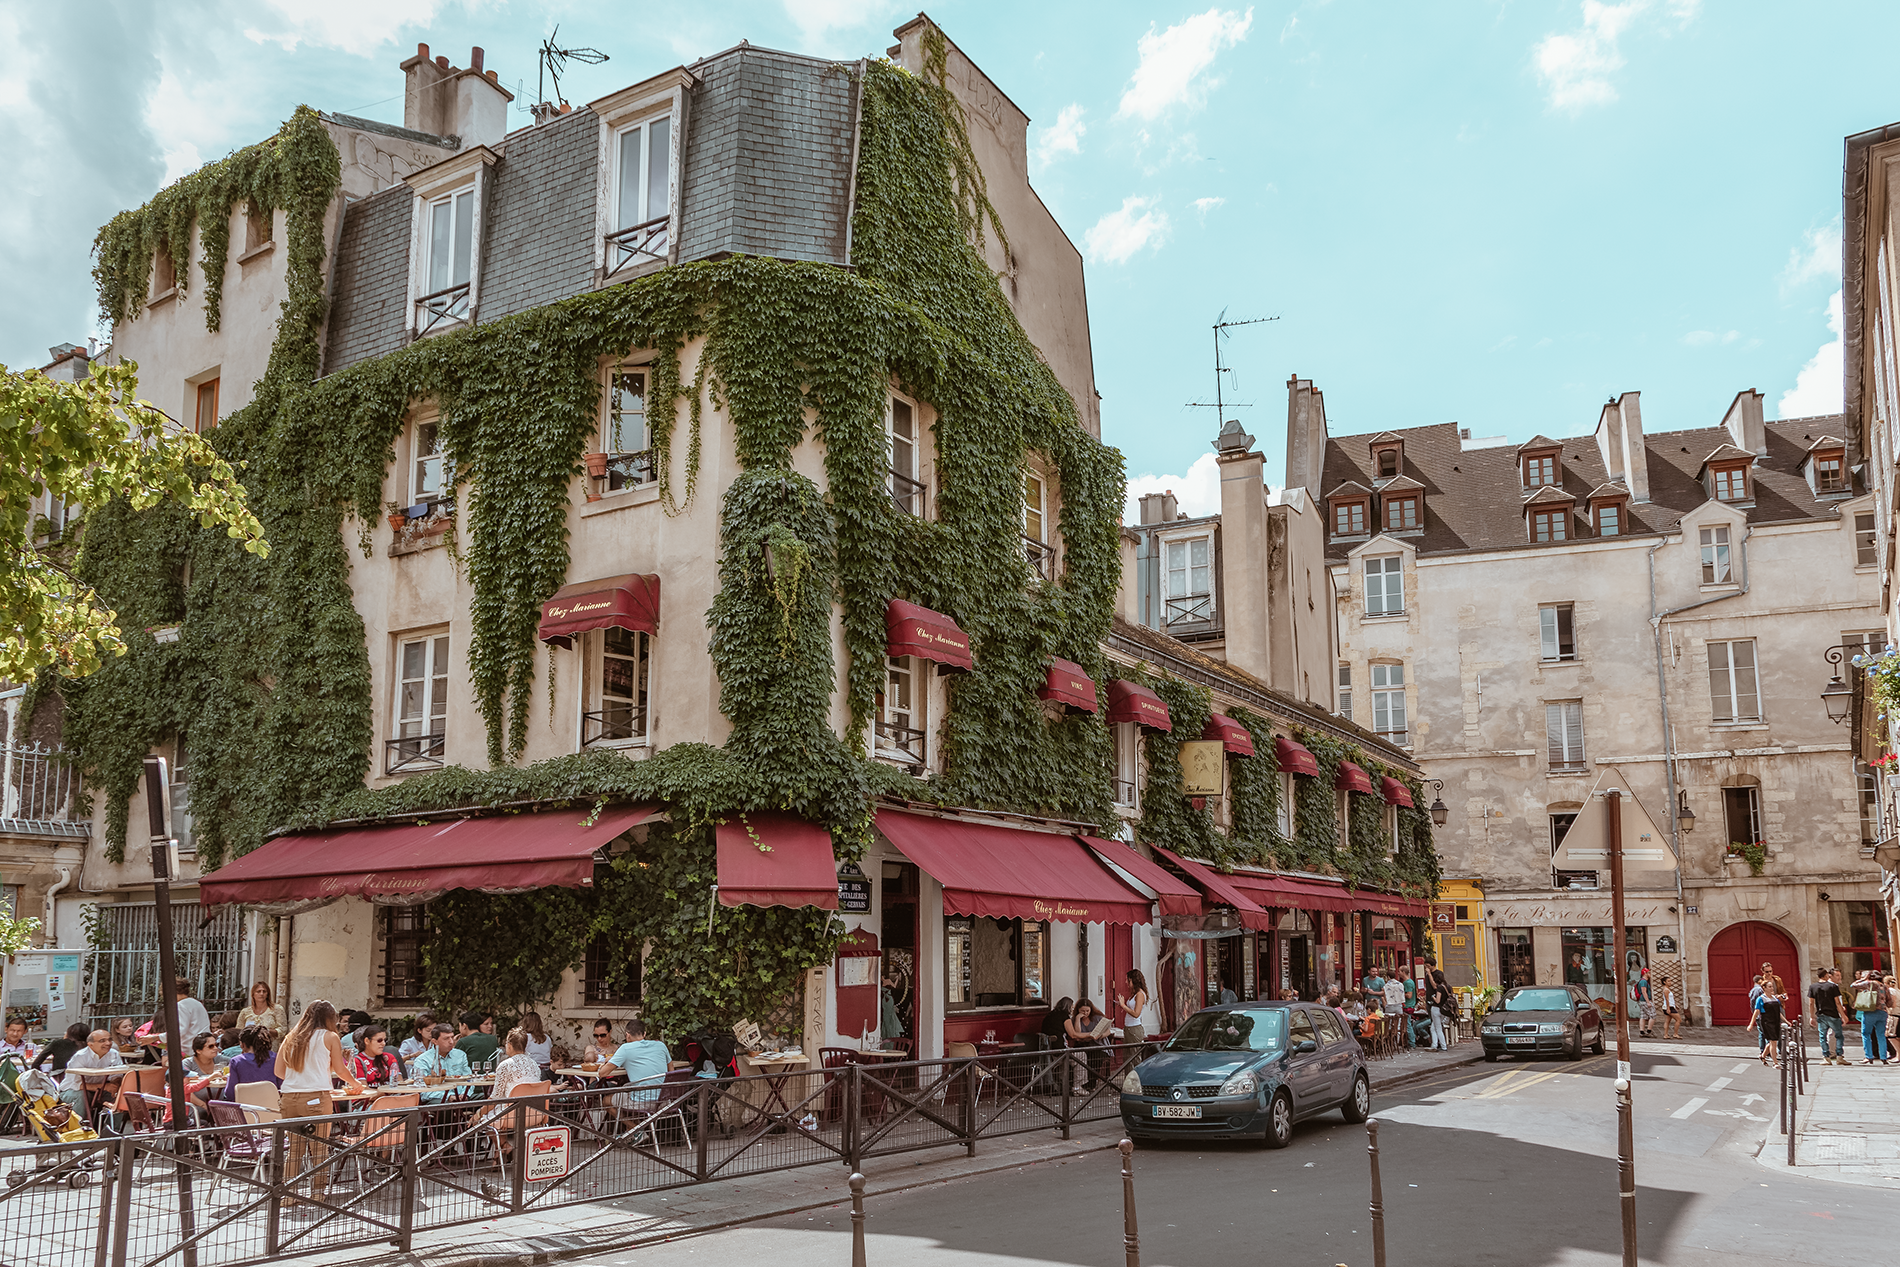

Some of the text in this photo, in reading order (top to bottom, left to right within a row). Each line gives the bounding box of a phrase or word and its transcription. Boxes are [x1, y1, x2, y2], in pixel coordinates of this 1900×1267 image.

[548, 601, 613, 619] Chez Marianne
[916, 627, 965, 649] Chez Marianne
[1070, 681, 1083, 691] VINS
[320, 873, 430, 895] Chez Marianne
[852, 883, 862, 891] DES
[838, 892, 867, 900] SPITALIÈRES
[1033, 899, 1089, 919] Chez Marianne
[1498, 903, 1658, 920] La Rose du Dsert
[537, 1157, 558, 1167] ACCÈS
[530, 1165, 564, 1176] POMPIERS
